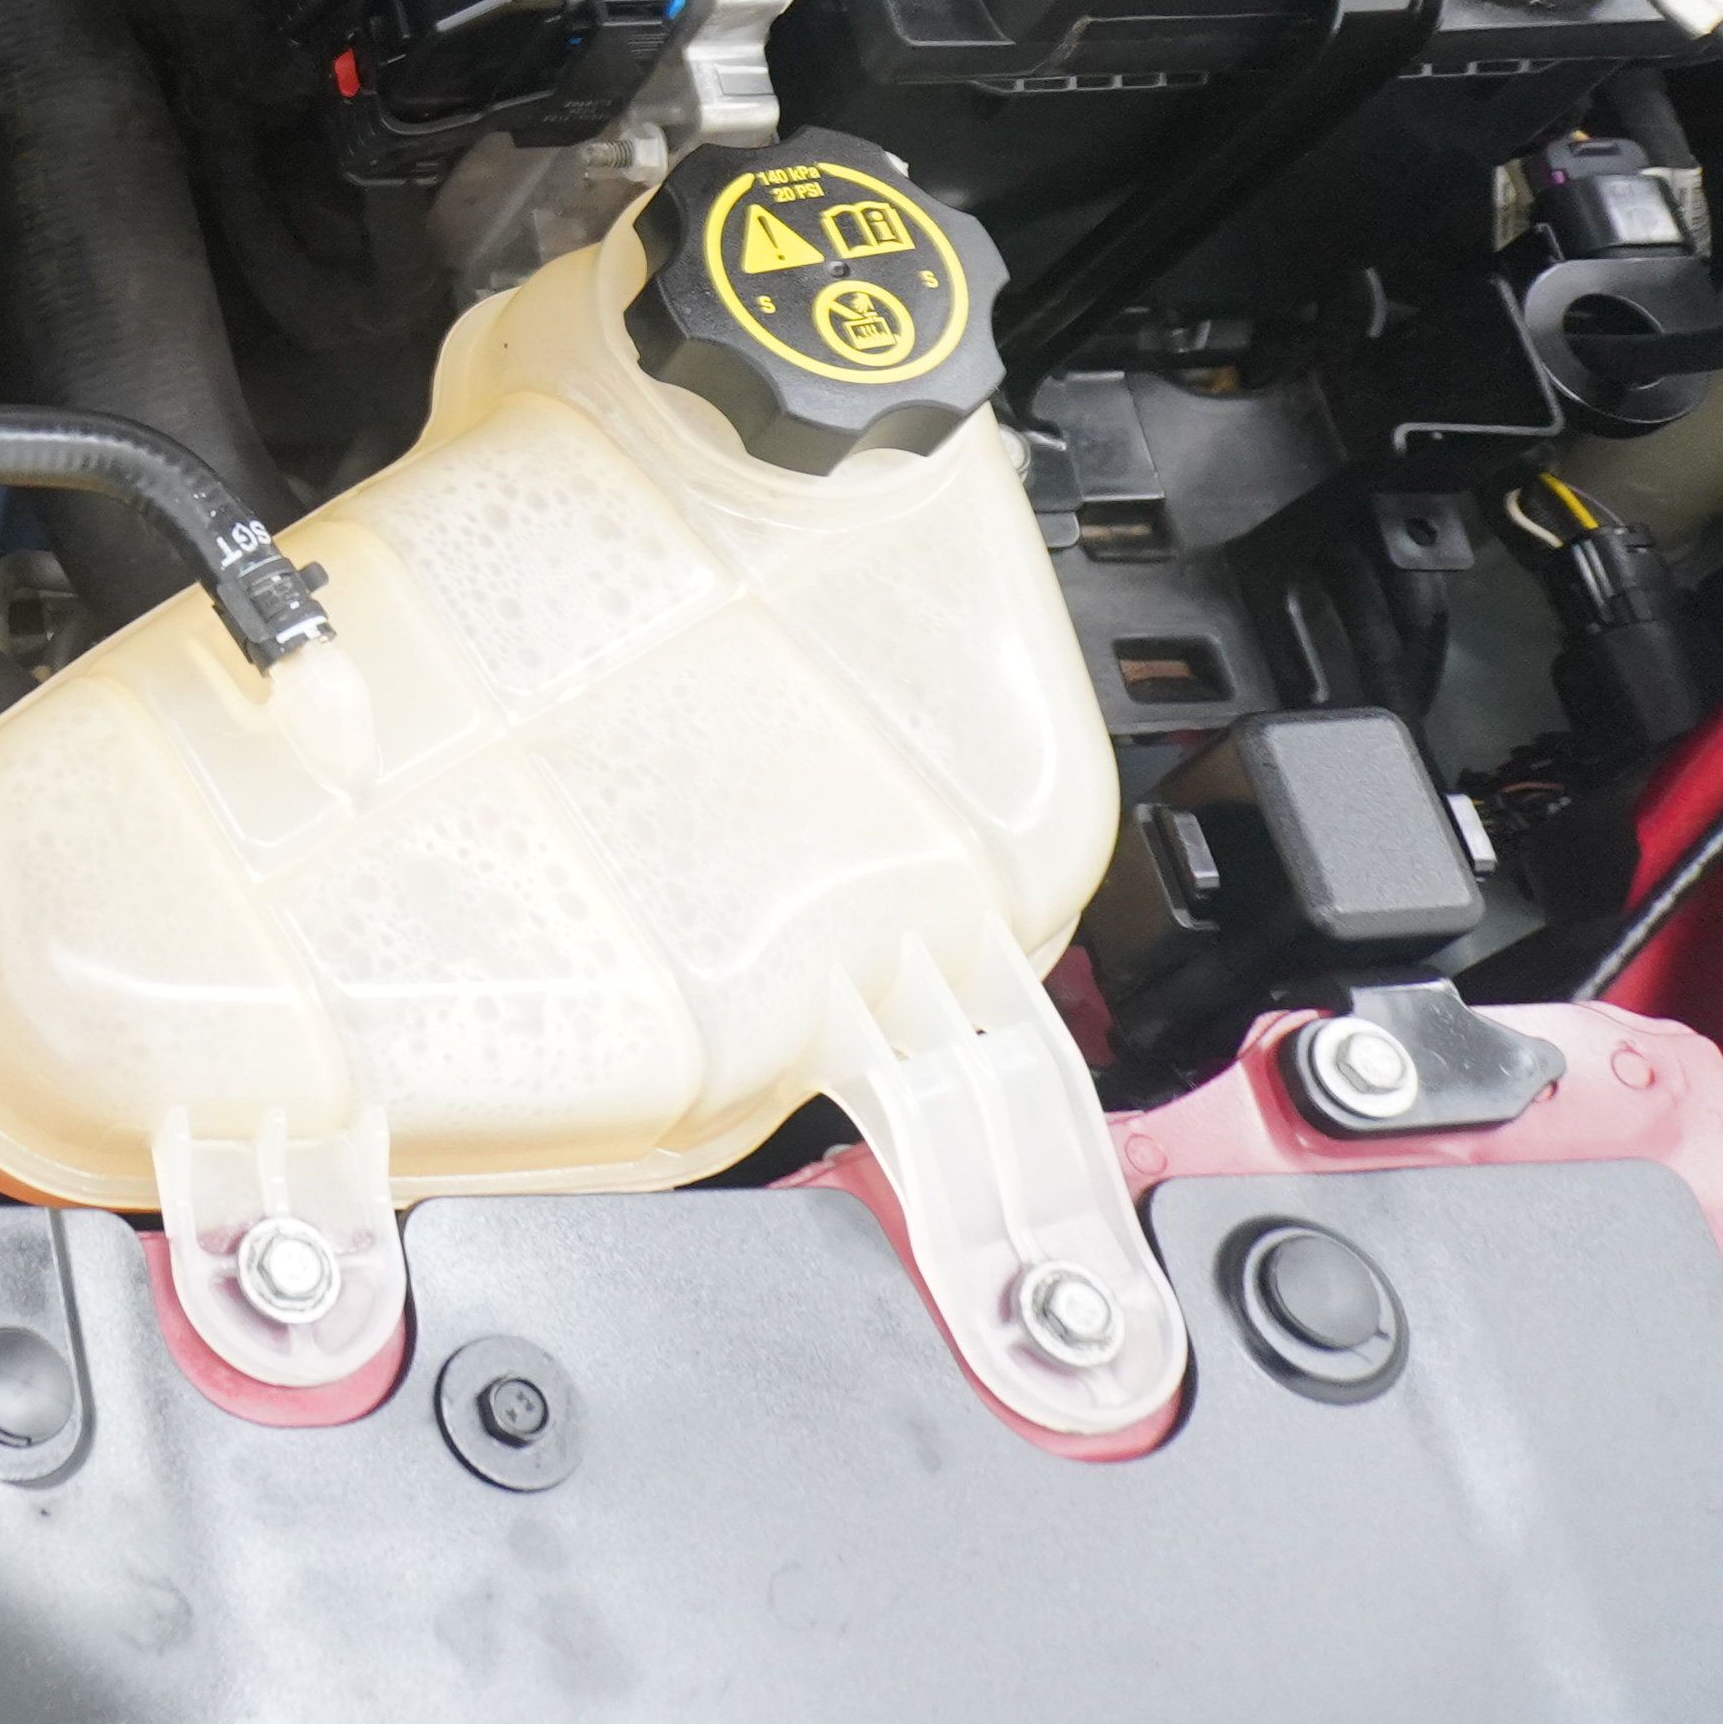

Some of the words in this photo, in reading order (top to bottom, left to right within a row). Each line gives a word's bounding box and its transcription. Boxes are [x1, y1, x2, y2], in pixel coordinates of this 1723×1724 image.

[757, 169, 790, 186] 140
[789, 164, 822, 181] kPa
[769, 187, 796, 203] 20
[794, 181, 825, 198] PSI
